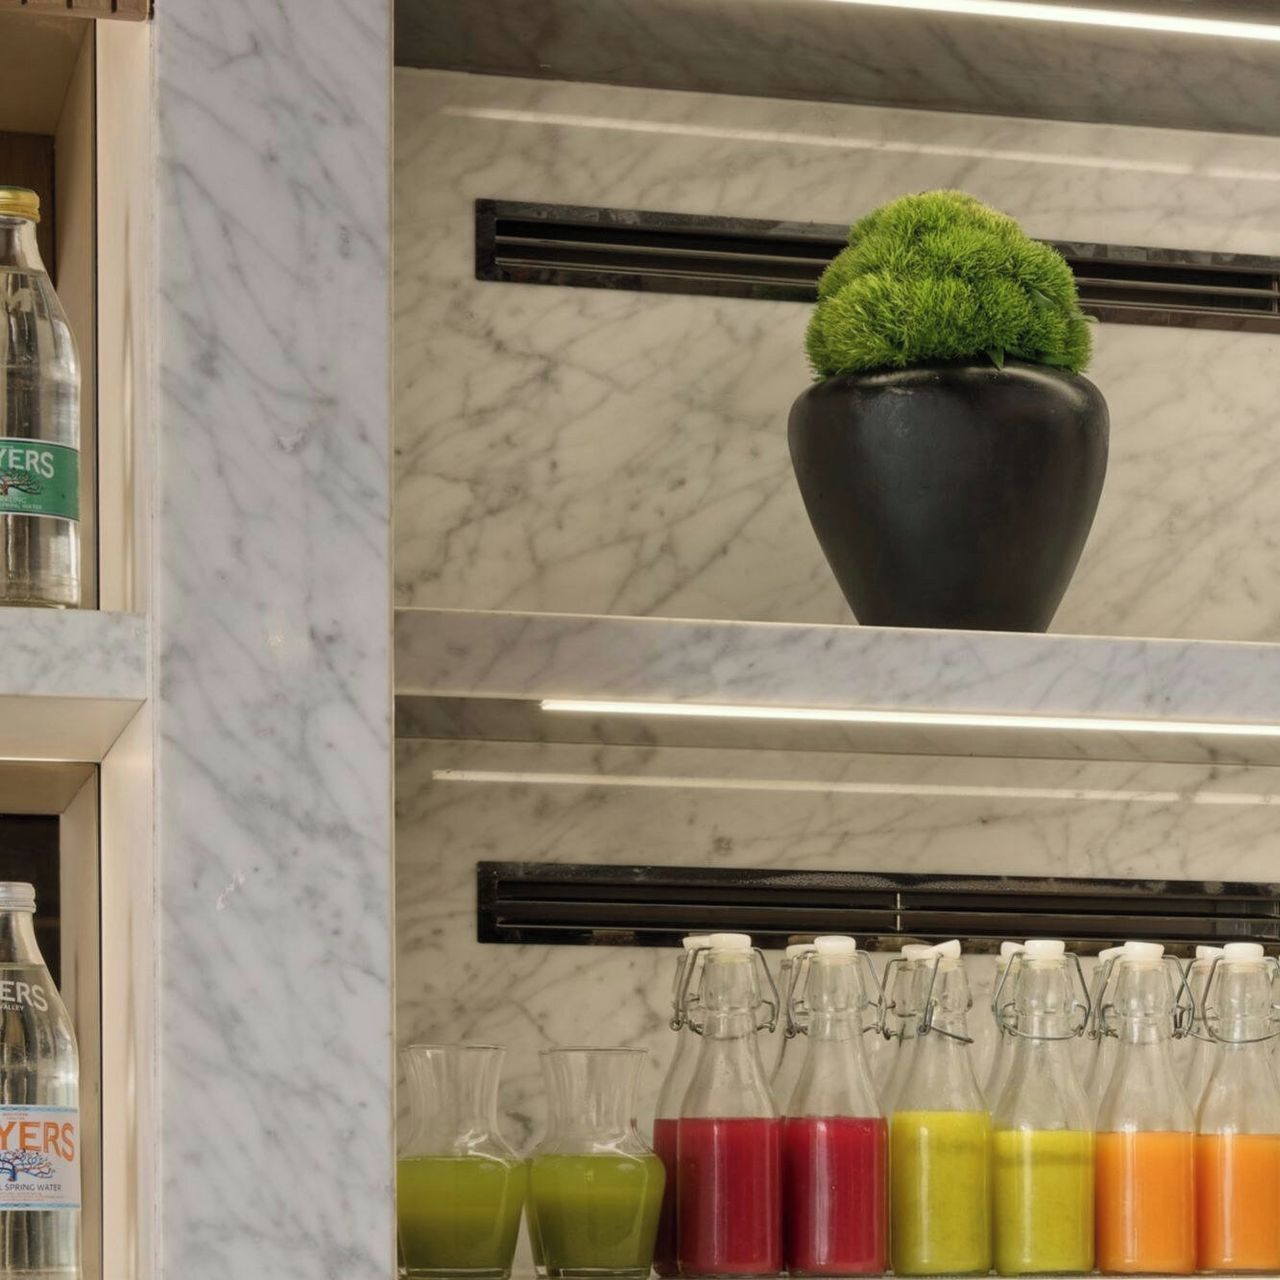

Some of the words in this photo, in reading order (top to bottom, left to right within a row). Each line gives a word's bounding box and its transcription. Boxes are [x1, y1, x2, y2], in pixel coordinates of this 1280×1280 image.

[0, 1121, 74, 1162] YERS
[4, 1183, 35, 1191] SPRING
[37, 1183, 62, 1192] WATER
